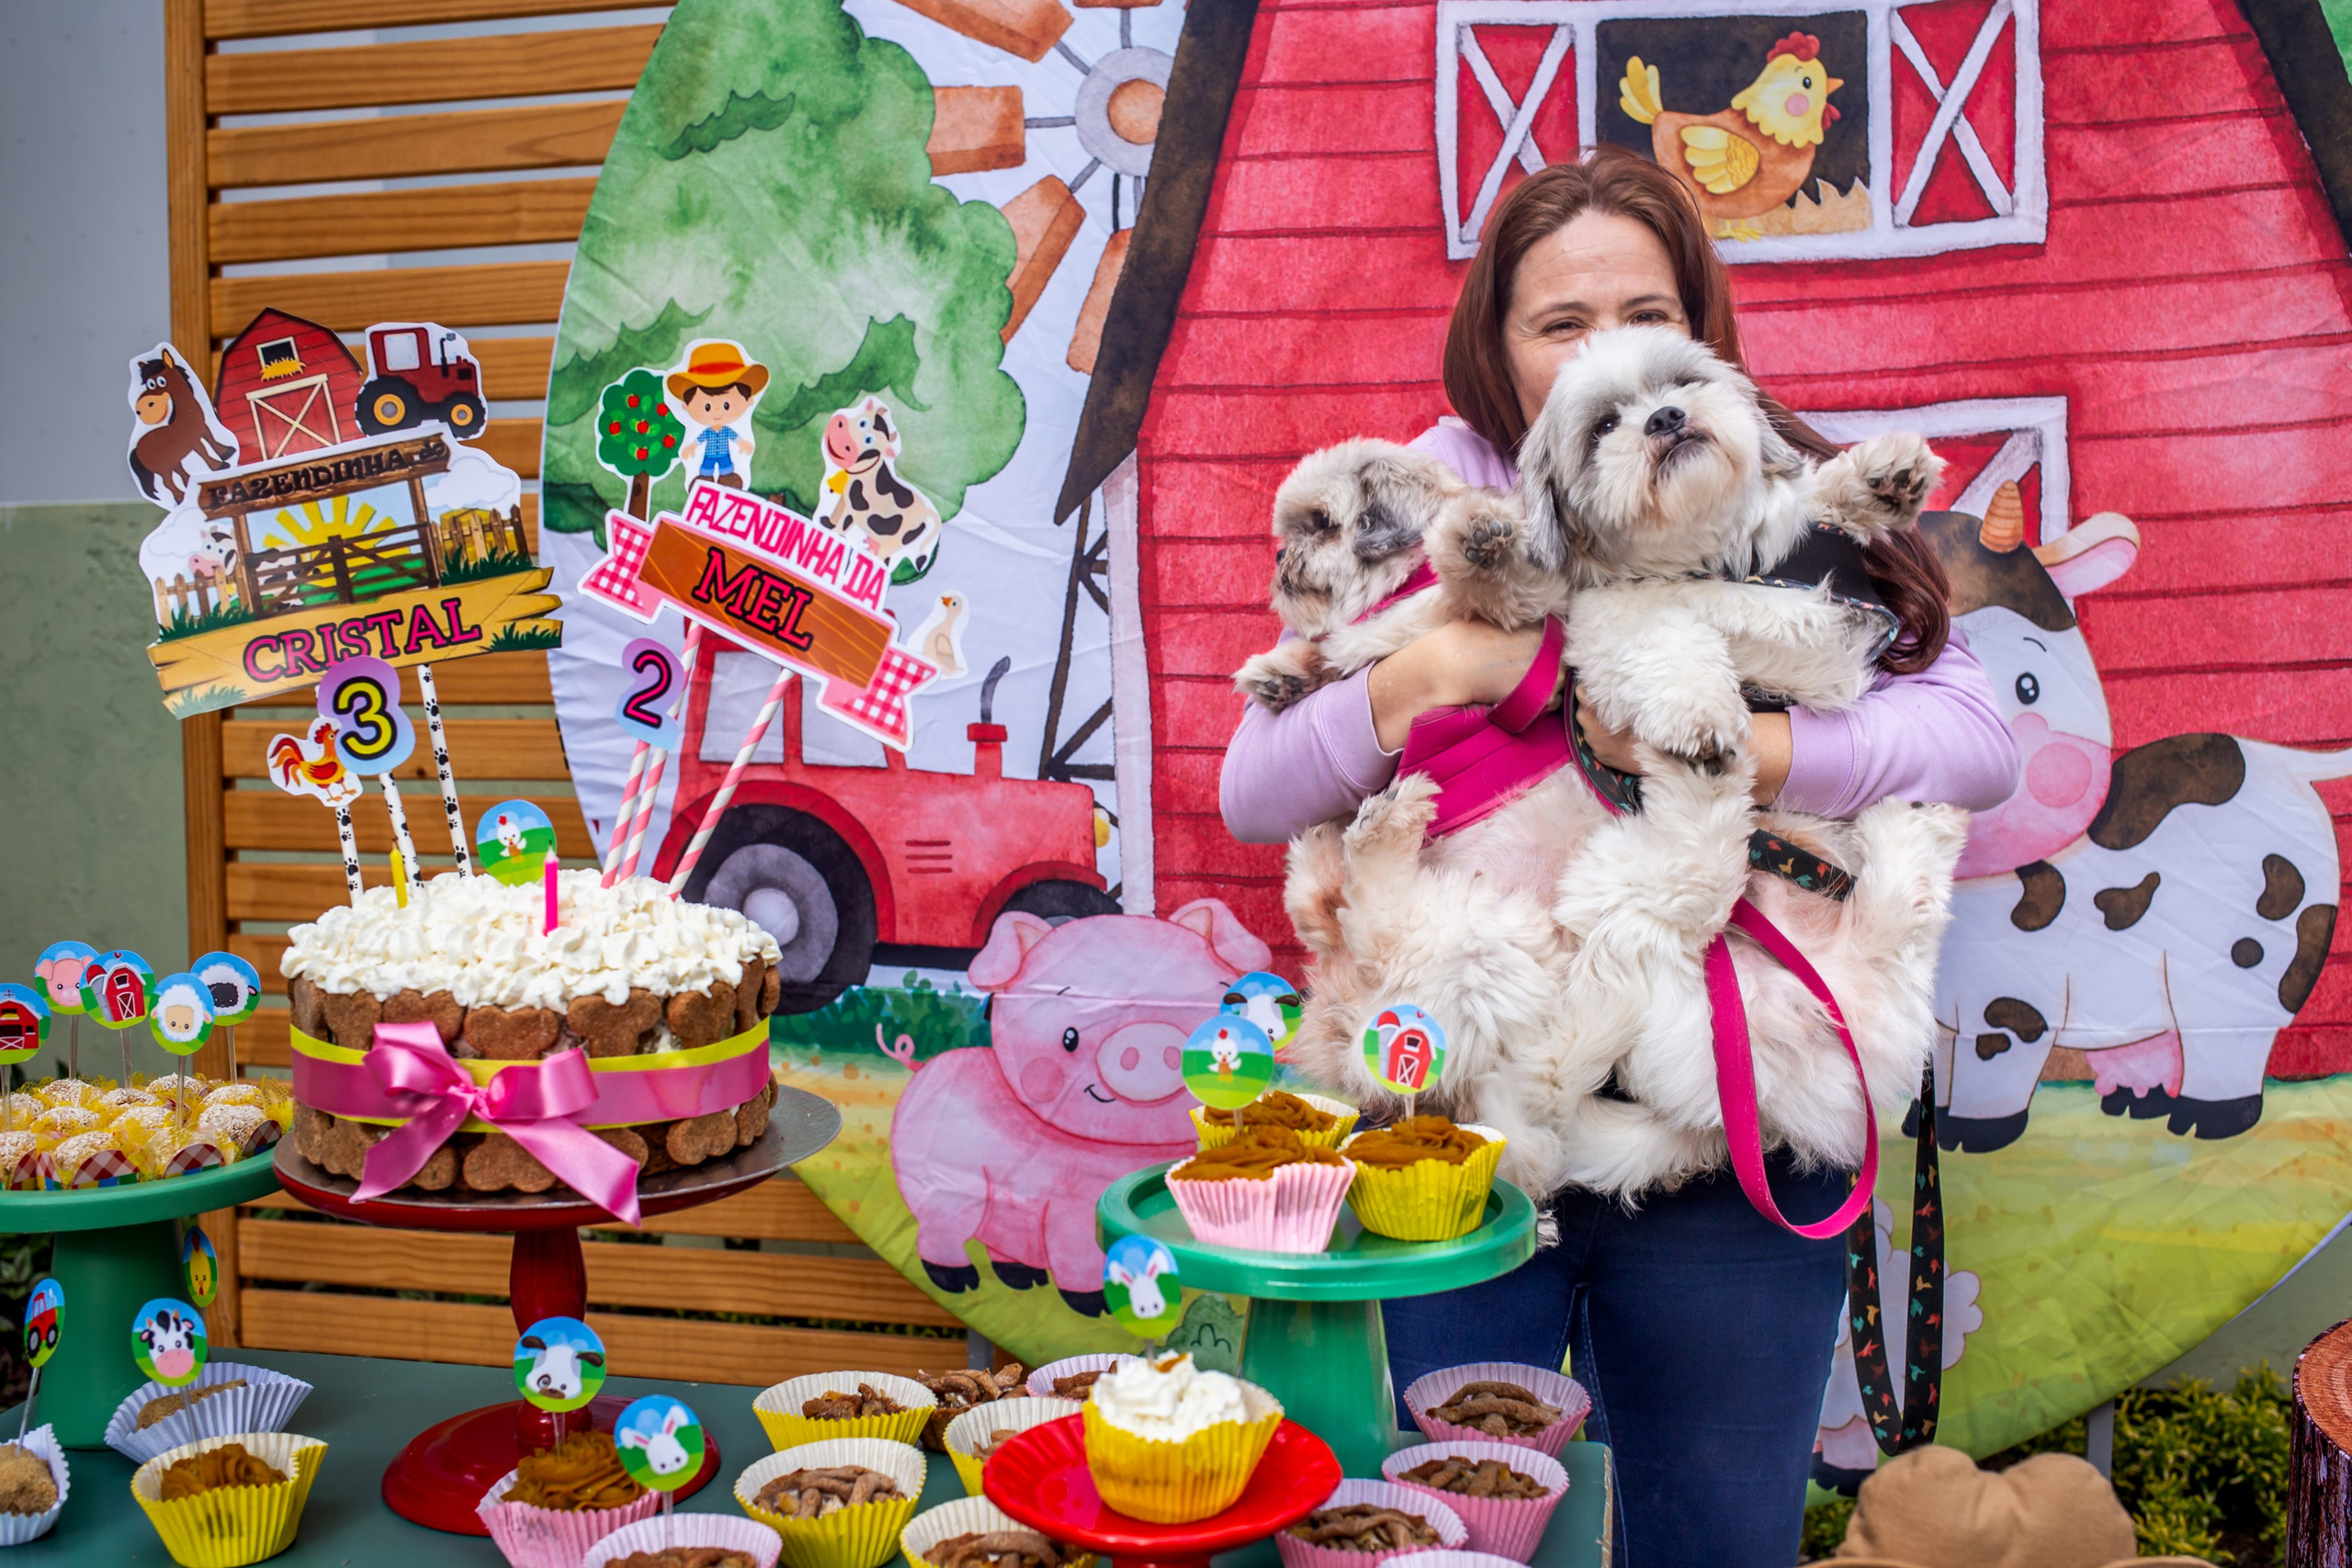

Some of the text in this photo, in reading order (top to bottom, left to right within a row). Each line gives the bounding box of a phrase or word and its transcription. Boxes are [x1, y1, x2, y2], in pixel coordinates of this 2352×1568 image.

[208, 447, 408, 509] FAZENDINHA
[685, 485, 886, 611] FAZENDINHA DA
[243, 597, 483, 682] CRISTAL
[692, 547, 815, 651] MEL
[333, 676, 398, 761] 3
[623, 649, 673, 729] 2
